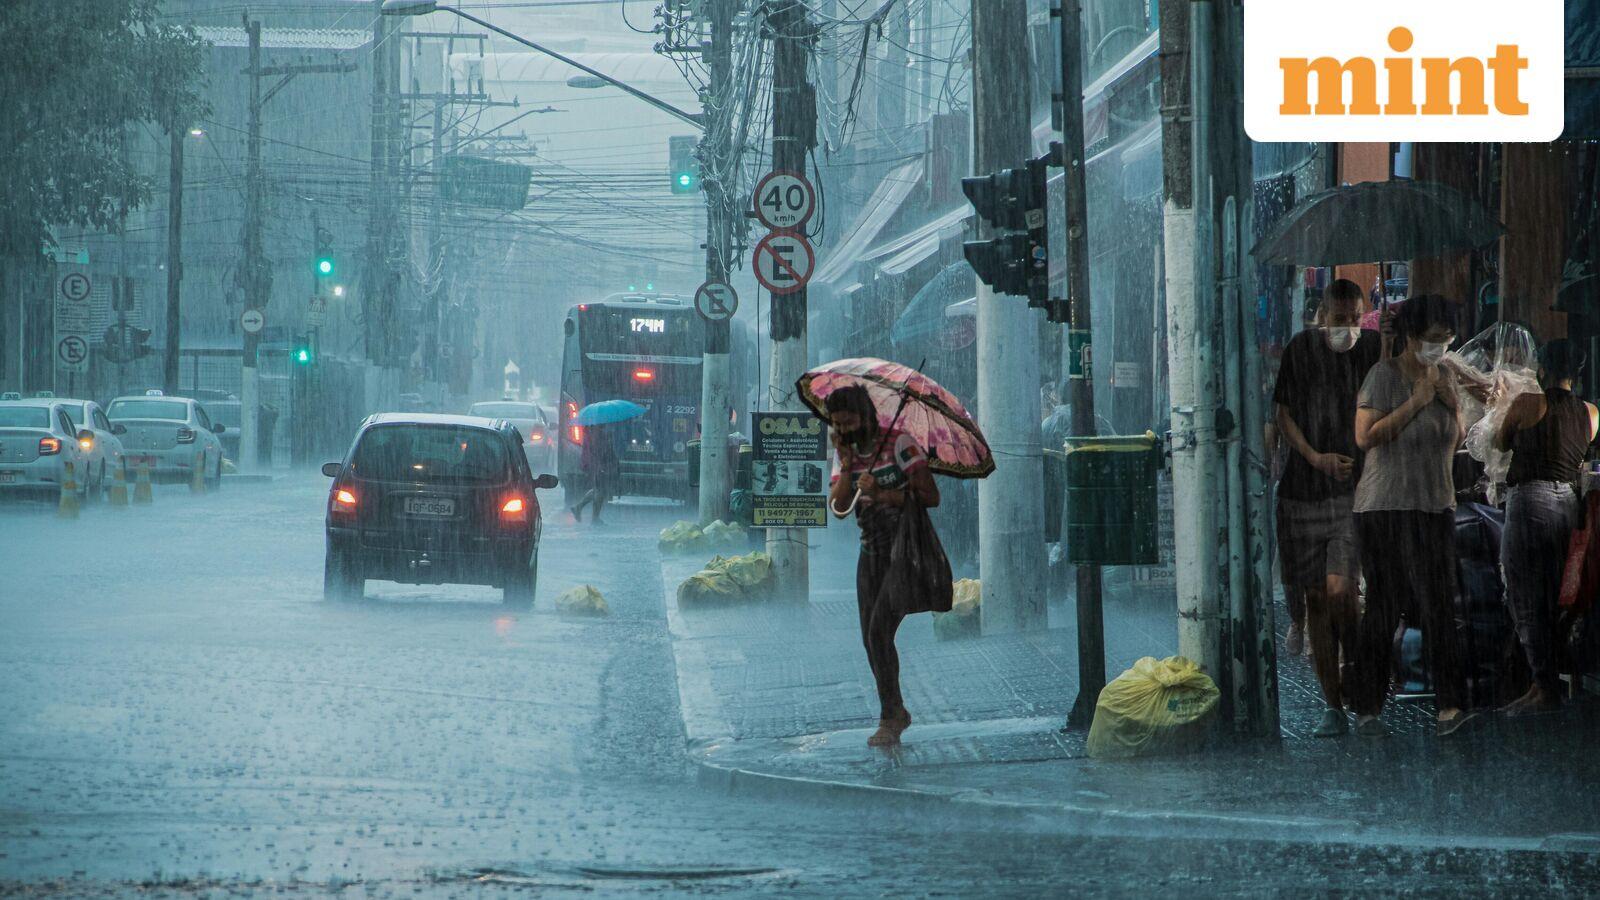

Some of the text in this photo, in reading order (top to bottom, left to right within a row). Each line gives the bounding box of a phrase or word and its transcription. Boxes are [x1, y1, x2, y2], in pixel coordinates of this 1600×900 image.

[762, 184, 805, 212] 40
[774, 214, 796, 223] km/h
[772, 245, 794, 281] E
[71, 279, 82, 296] E
[708, 288, 725, 314] E
[630, 318, 665, 333] 174M
